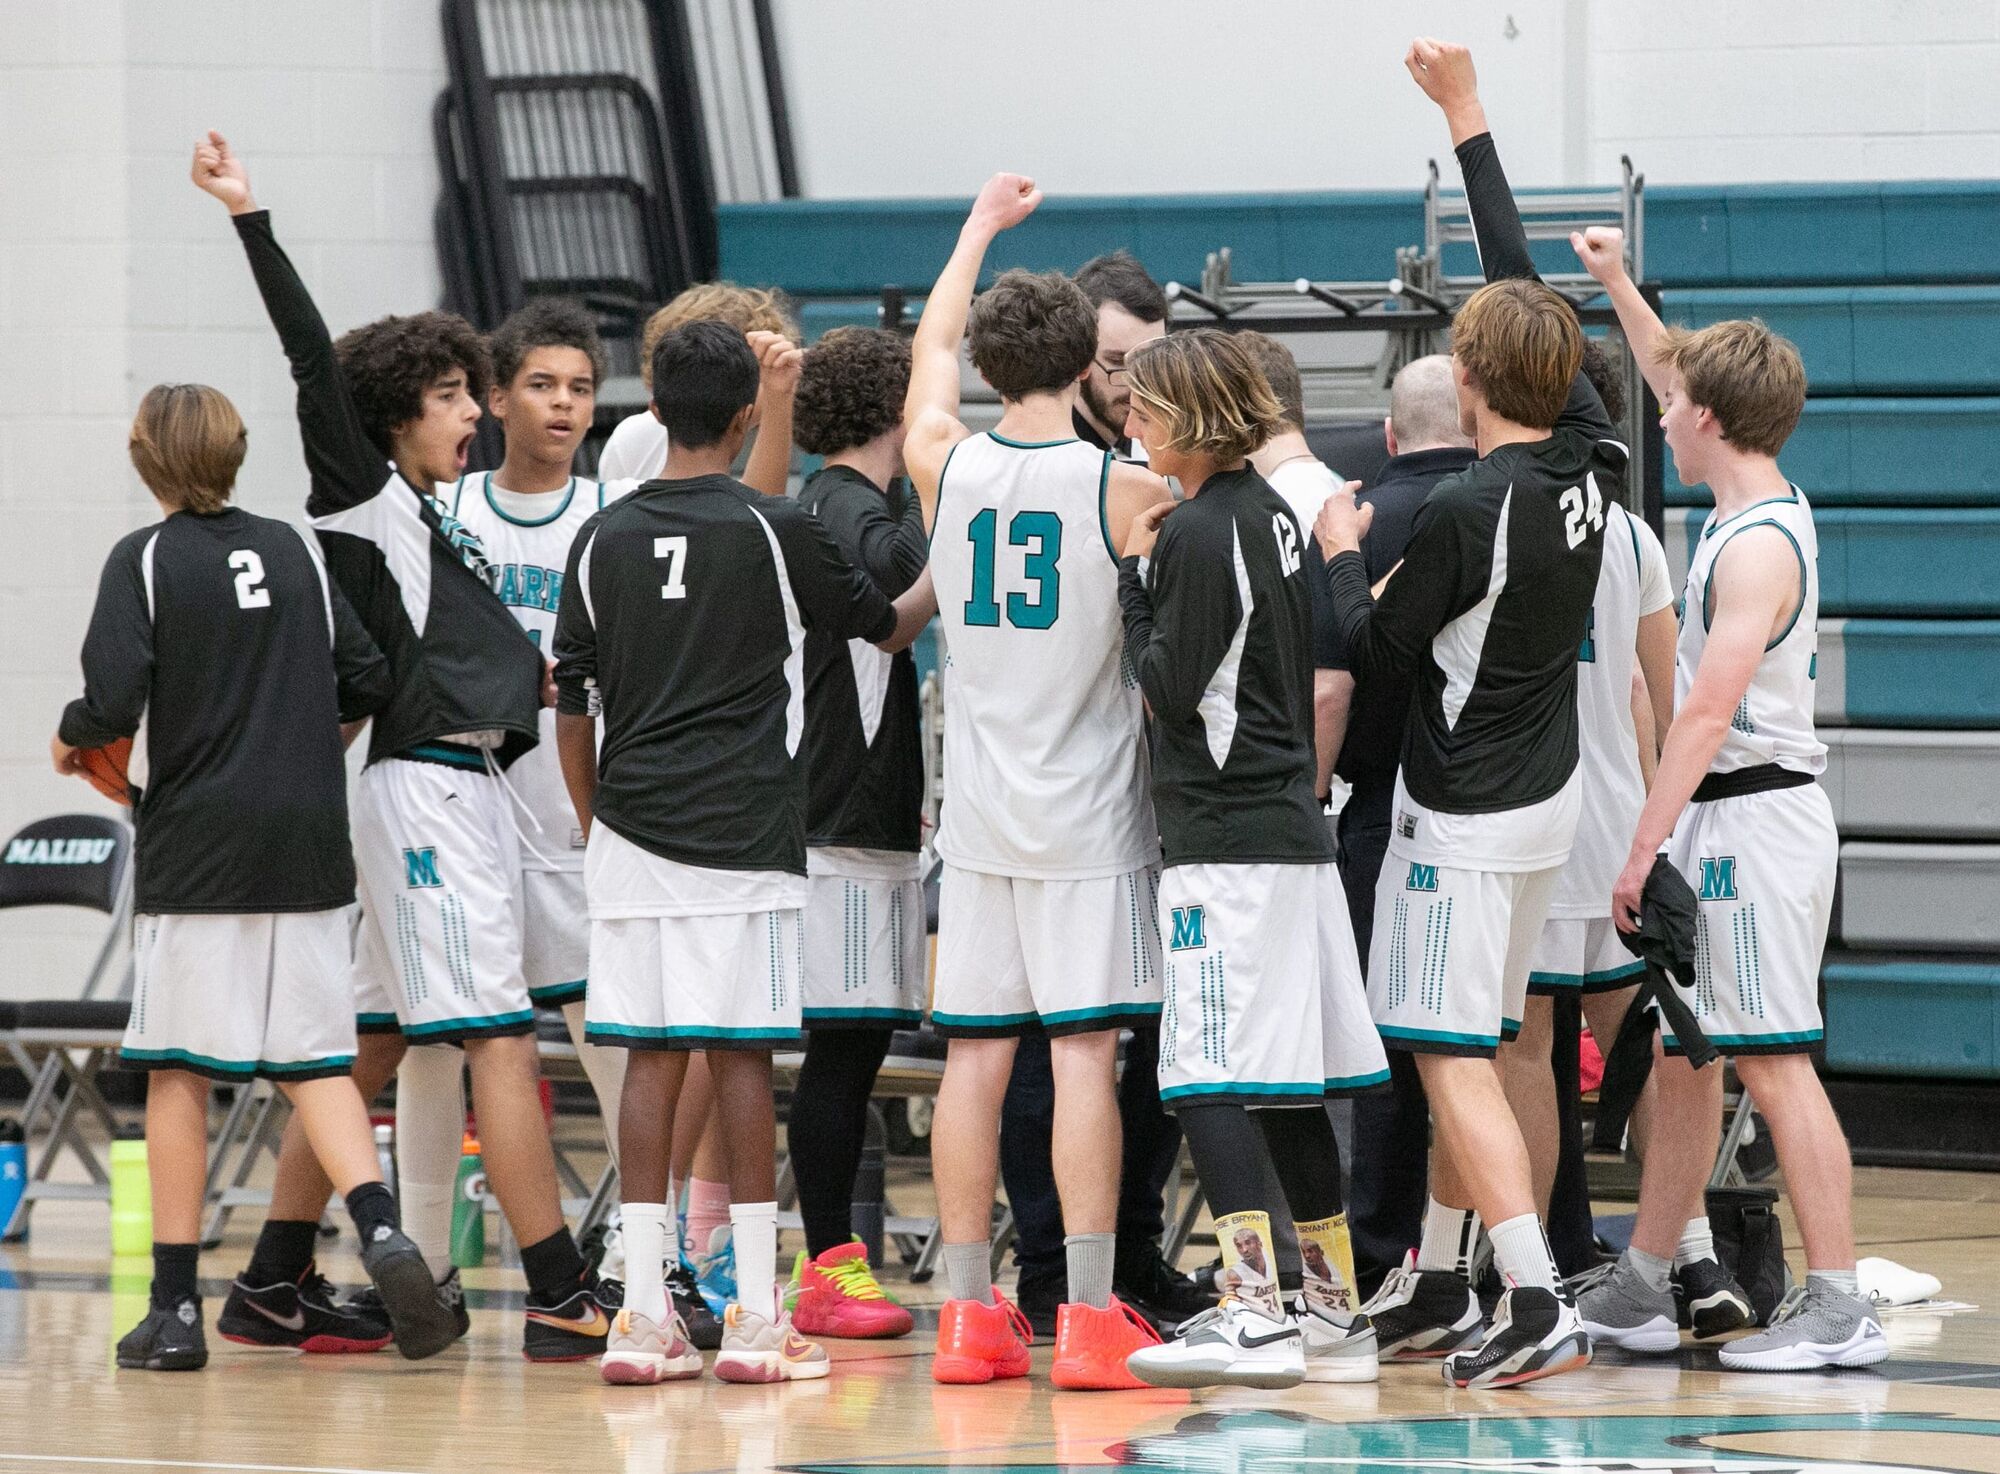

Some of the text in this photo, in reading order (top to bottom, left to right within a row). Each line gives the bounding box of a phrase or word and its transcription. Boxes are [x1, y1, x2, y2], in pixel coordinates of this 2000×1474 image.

[1559, 471, 1604, 550] 24
[654, 536, 687, 599] 7
[1272, 512, 1301, 578] 12
[228, 549, 271, 609] 2
[964, 508, 1062, 630] 13
[4, 838, 116, 864] MALIBU
[402, 846, 445, 889] M
[1406, 862, 1439, 892] M
[1699, 856, 1738, 901] M
[1170, 905, 1206, 952] M
[1214, 1214, 1267, 1231] OBE BRYANT
[1298, 1222, 1329, 1233] BRYANT
[1322, 1295, 1350, 1311] 24
